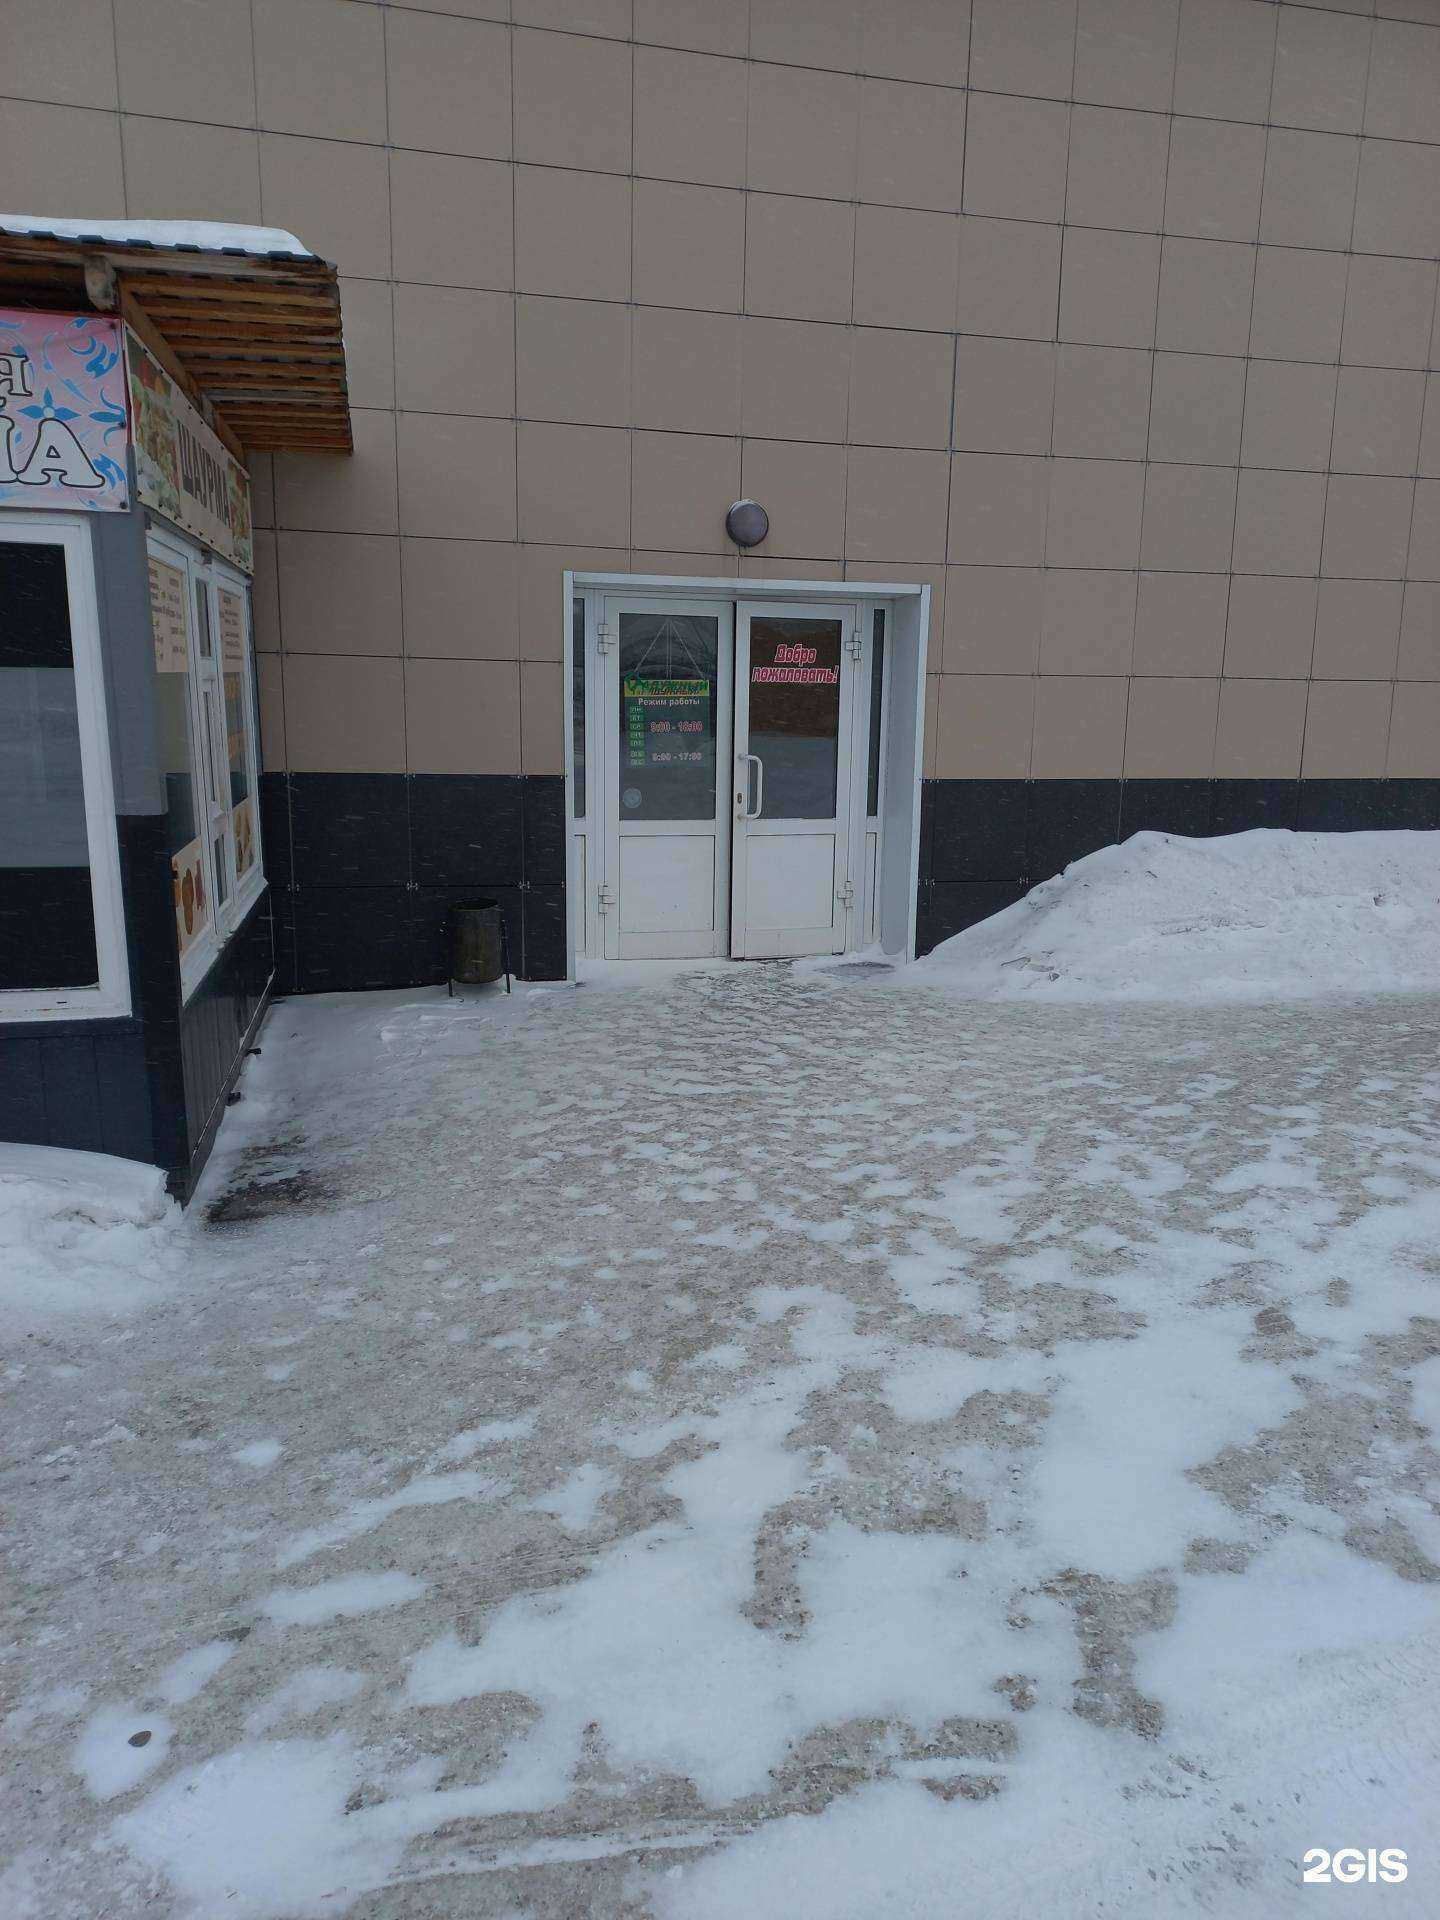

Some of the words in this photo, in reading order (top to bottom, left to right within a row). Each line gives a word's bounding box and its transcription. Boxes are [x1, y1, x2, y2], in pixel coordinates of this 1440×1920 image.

[176, 418, 231, 529] ШАУРМА
[774, 643, 817, 668] Добро
[751, 664, 839, 684] пожаловать!
[638, 697, 667, 706] Режим
[669, 697, 700, 707] работы
